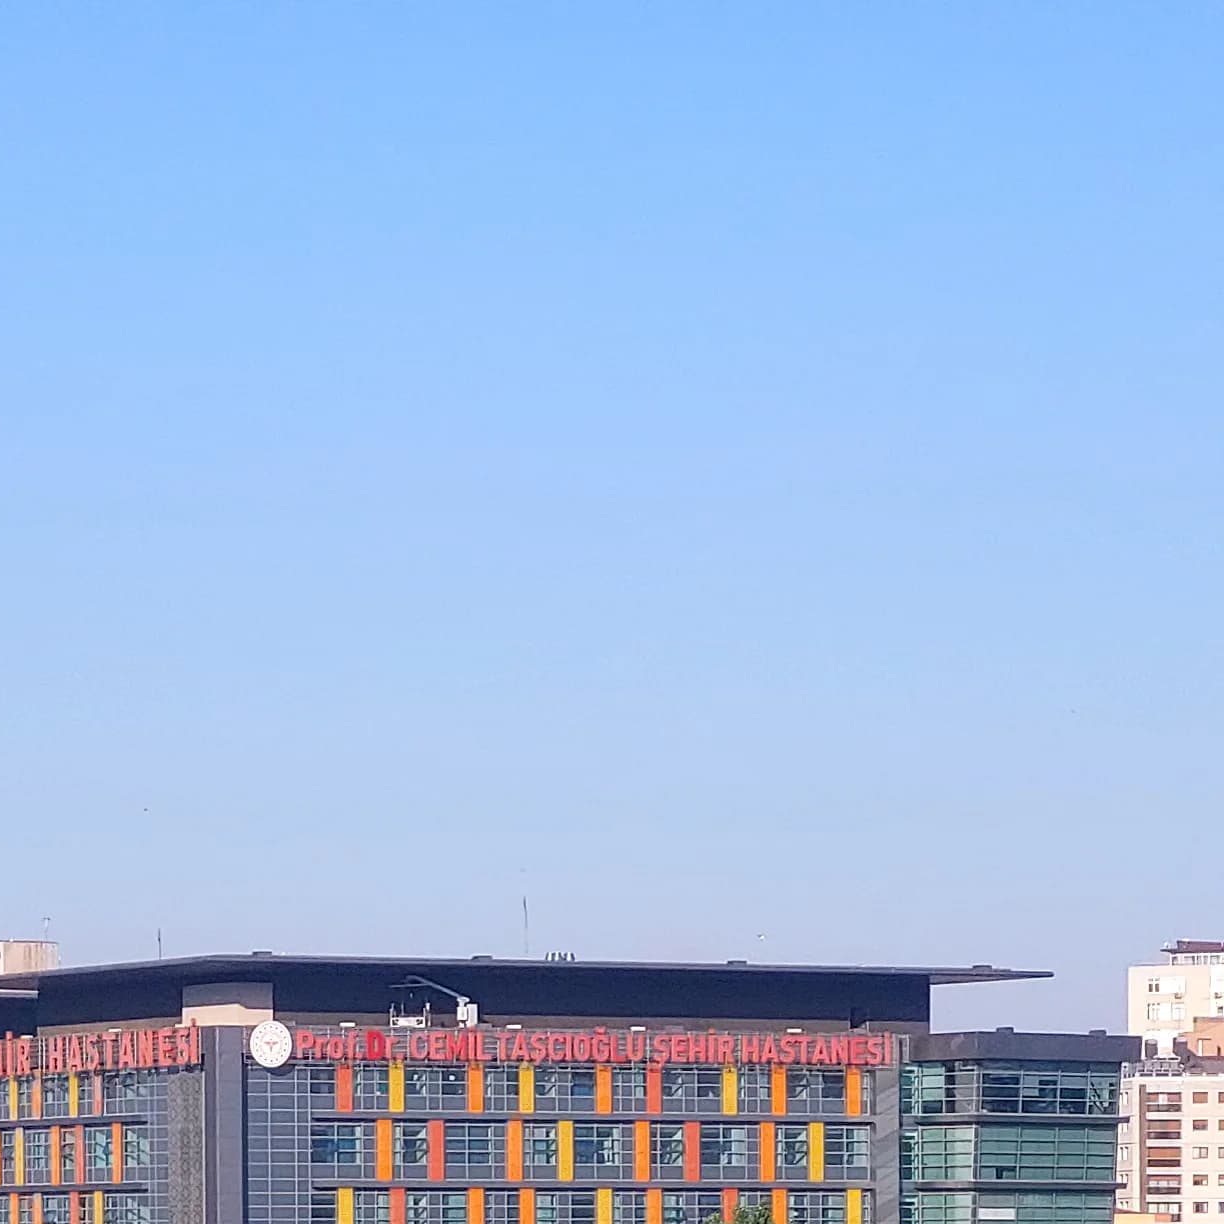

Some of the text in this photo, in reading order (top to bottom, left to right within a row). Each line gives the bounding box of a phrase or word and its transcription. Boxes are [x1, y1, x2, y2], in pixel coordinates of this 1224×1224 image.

[48, 1018, 199, 1073] HASTANESİ
[409, 1026, 493, 1061] CEMİL
[496, 1026, 644, 1064] TAŞCIOĞLU
[652, 1028, 734, 1067] ŞEHİR
[741, 1030, 893, 1065] HASTANESİ
